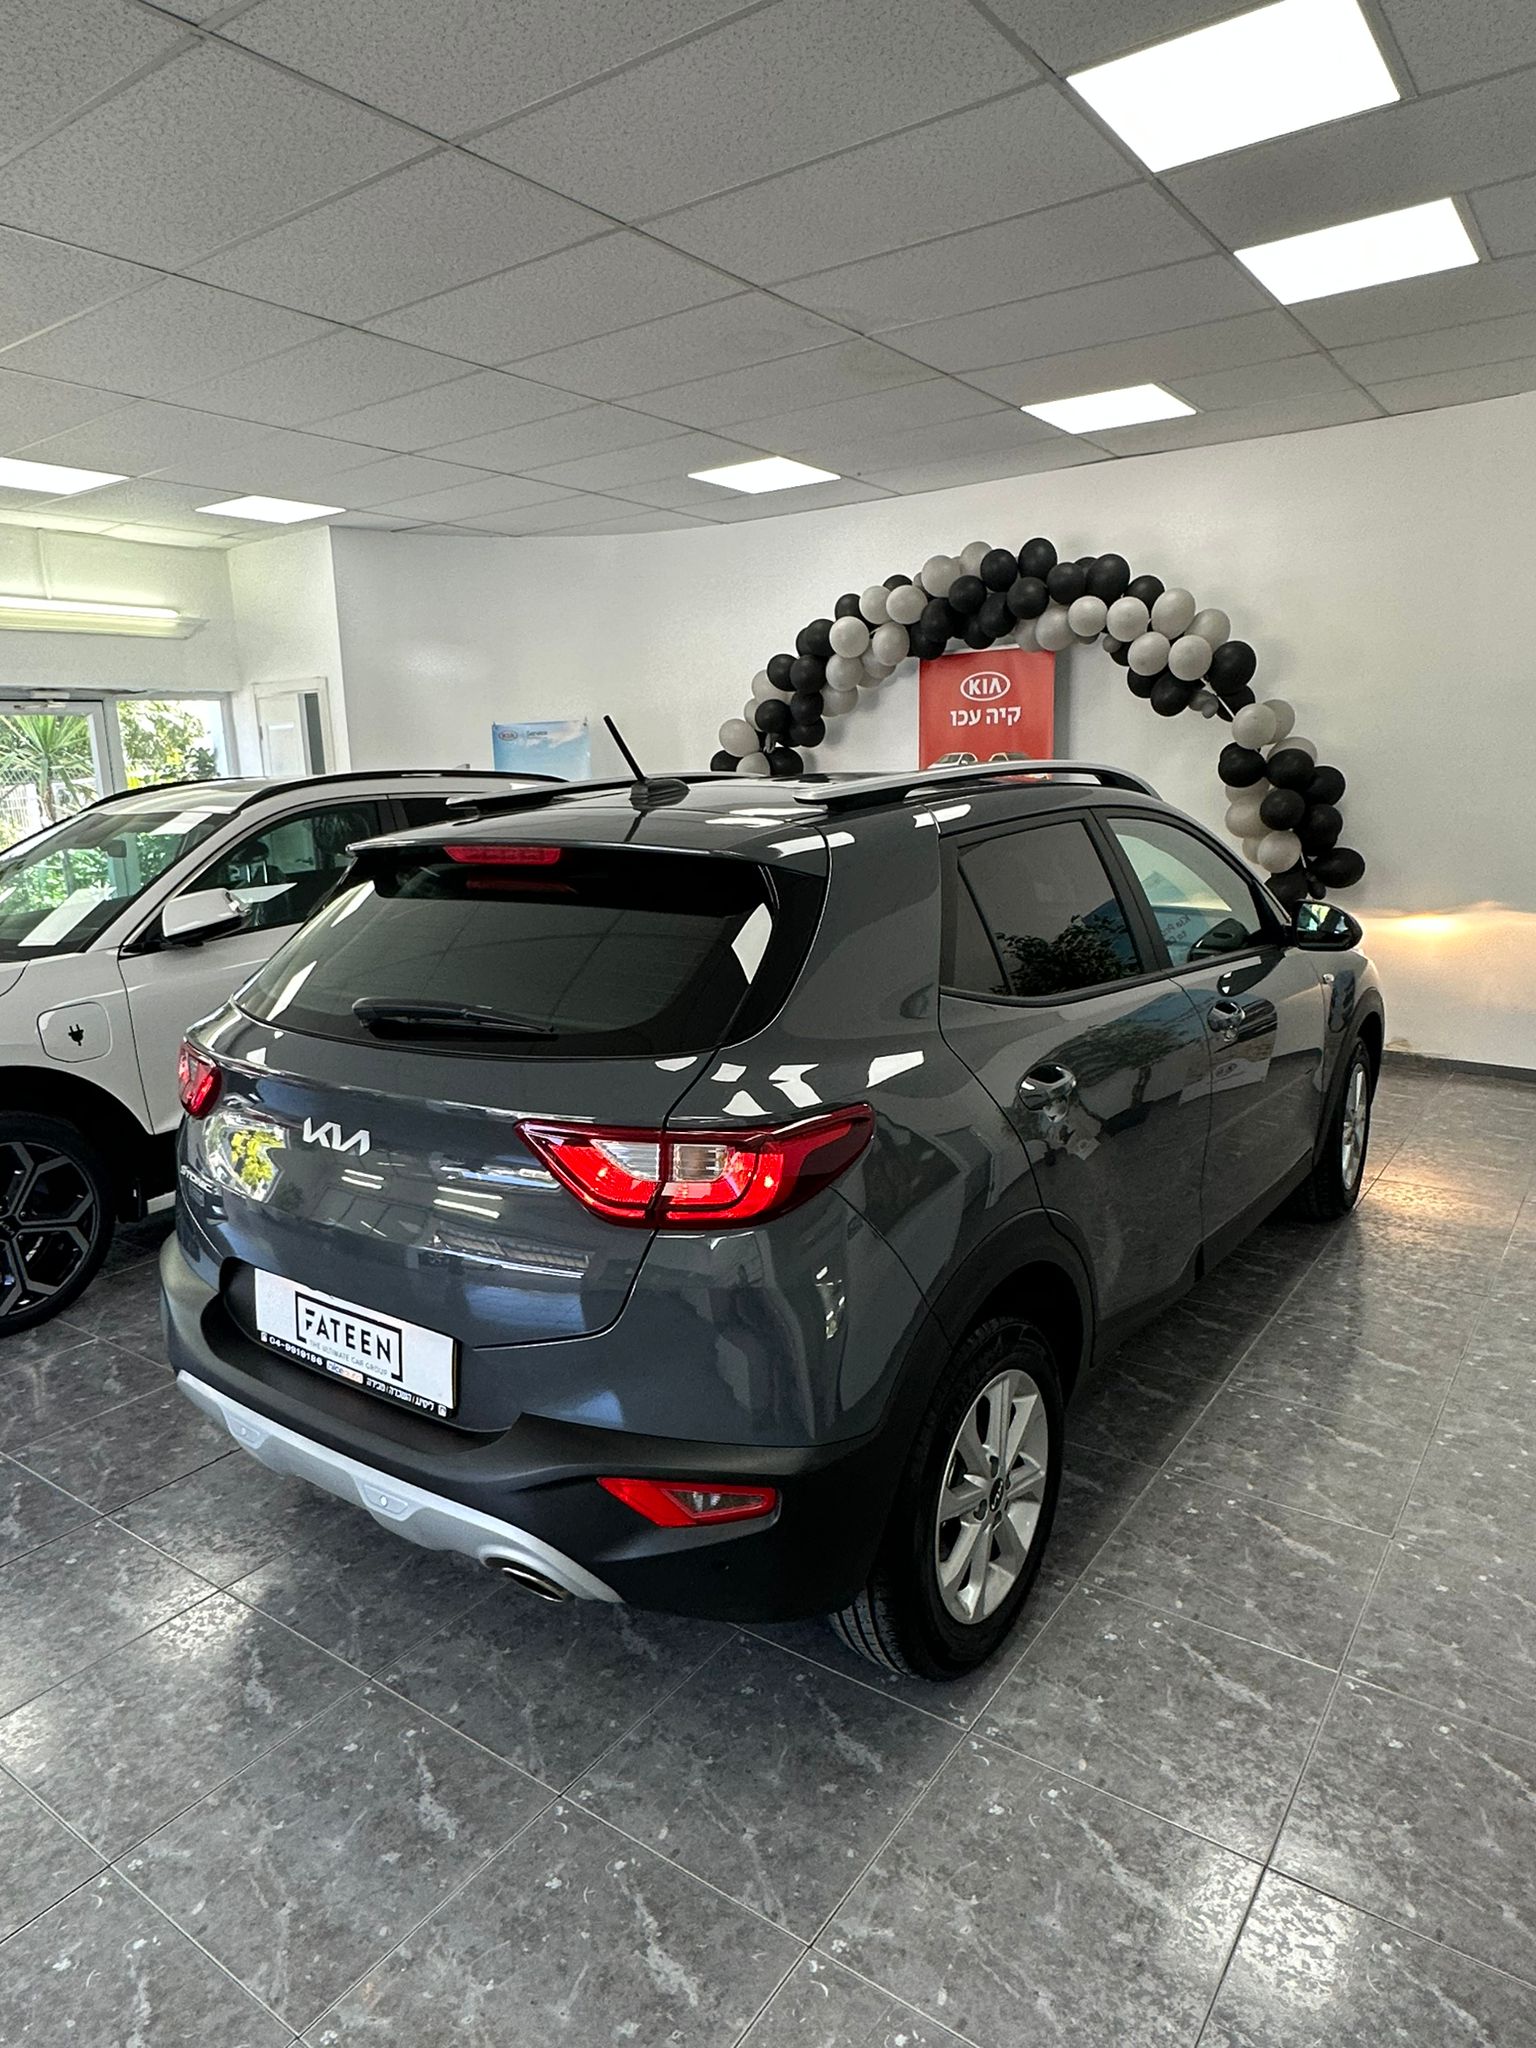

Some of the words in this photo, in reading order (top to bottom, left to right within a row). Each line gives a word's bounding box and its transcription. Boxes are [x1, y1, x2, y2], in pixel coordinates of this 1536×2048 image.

[968, 678, 1002, 695] KIA
[950, 708, 982, 727] עכו
[985, 706, 1022, 726] קיה
[303, 1116, 370, 1157] KIA
[180, 1164, 214, 1194] STONIC
[304, 1307, 392, 1363] FATEEN
